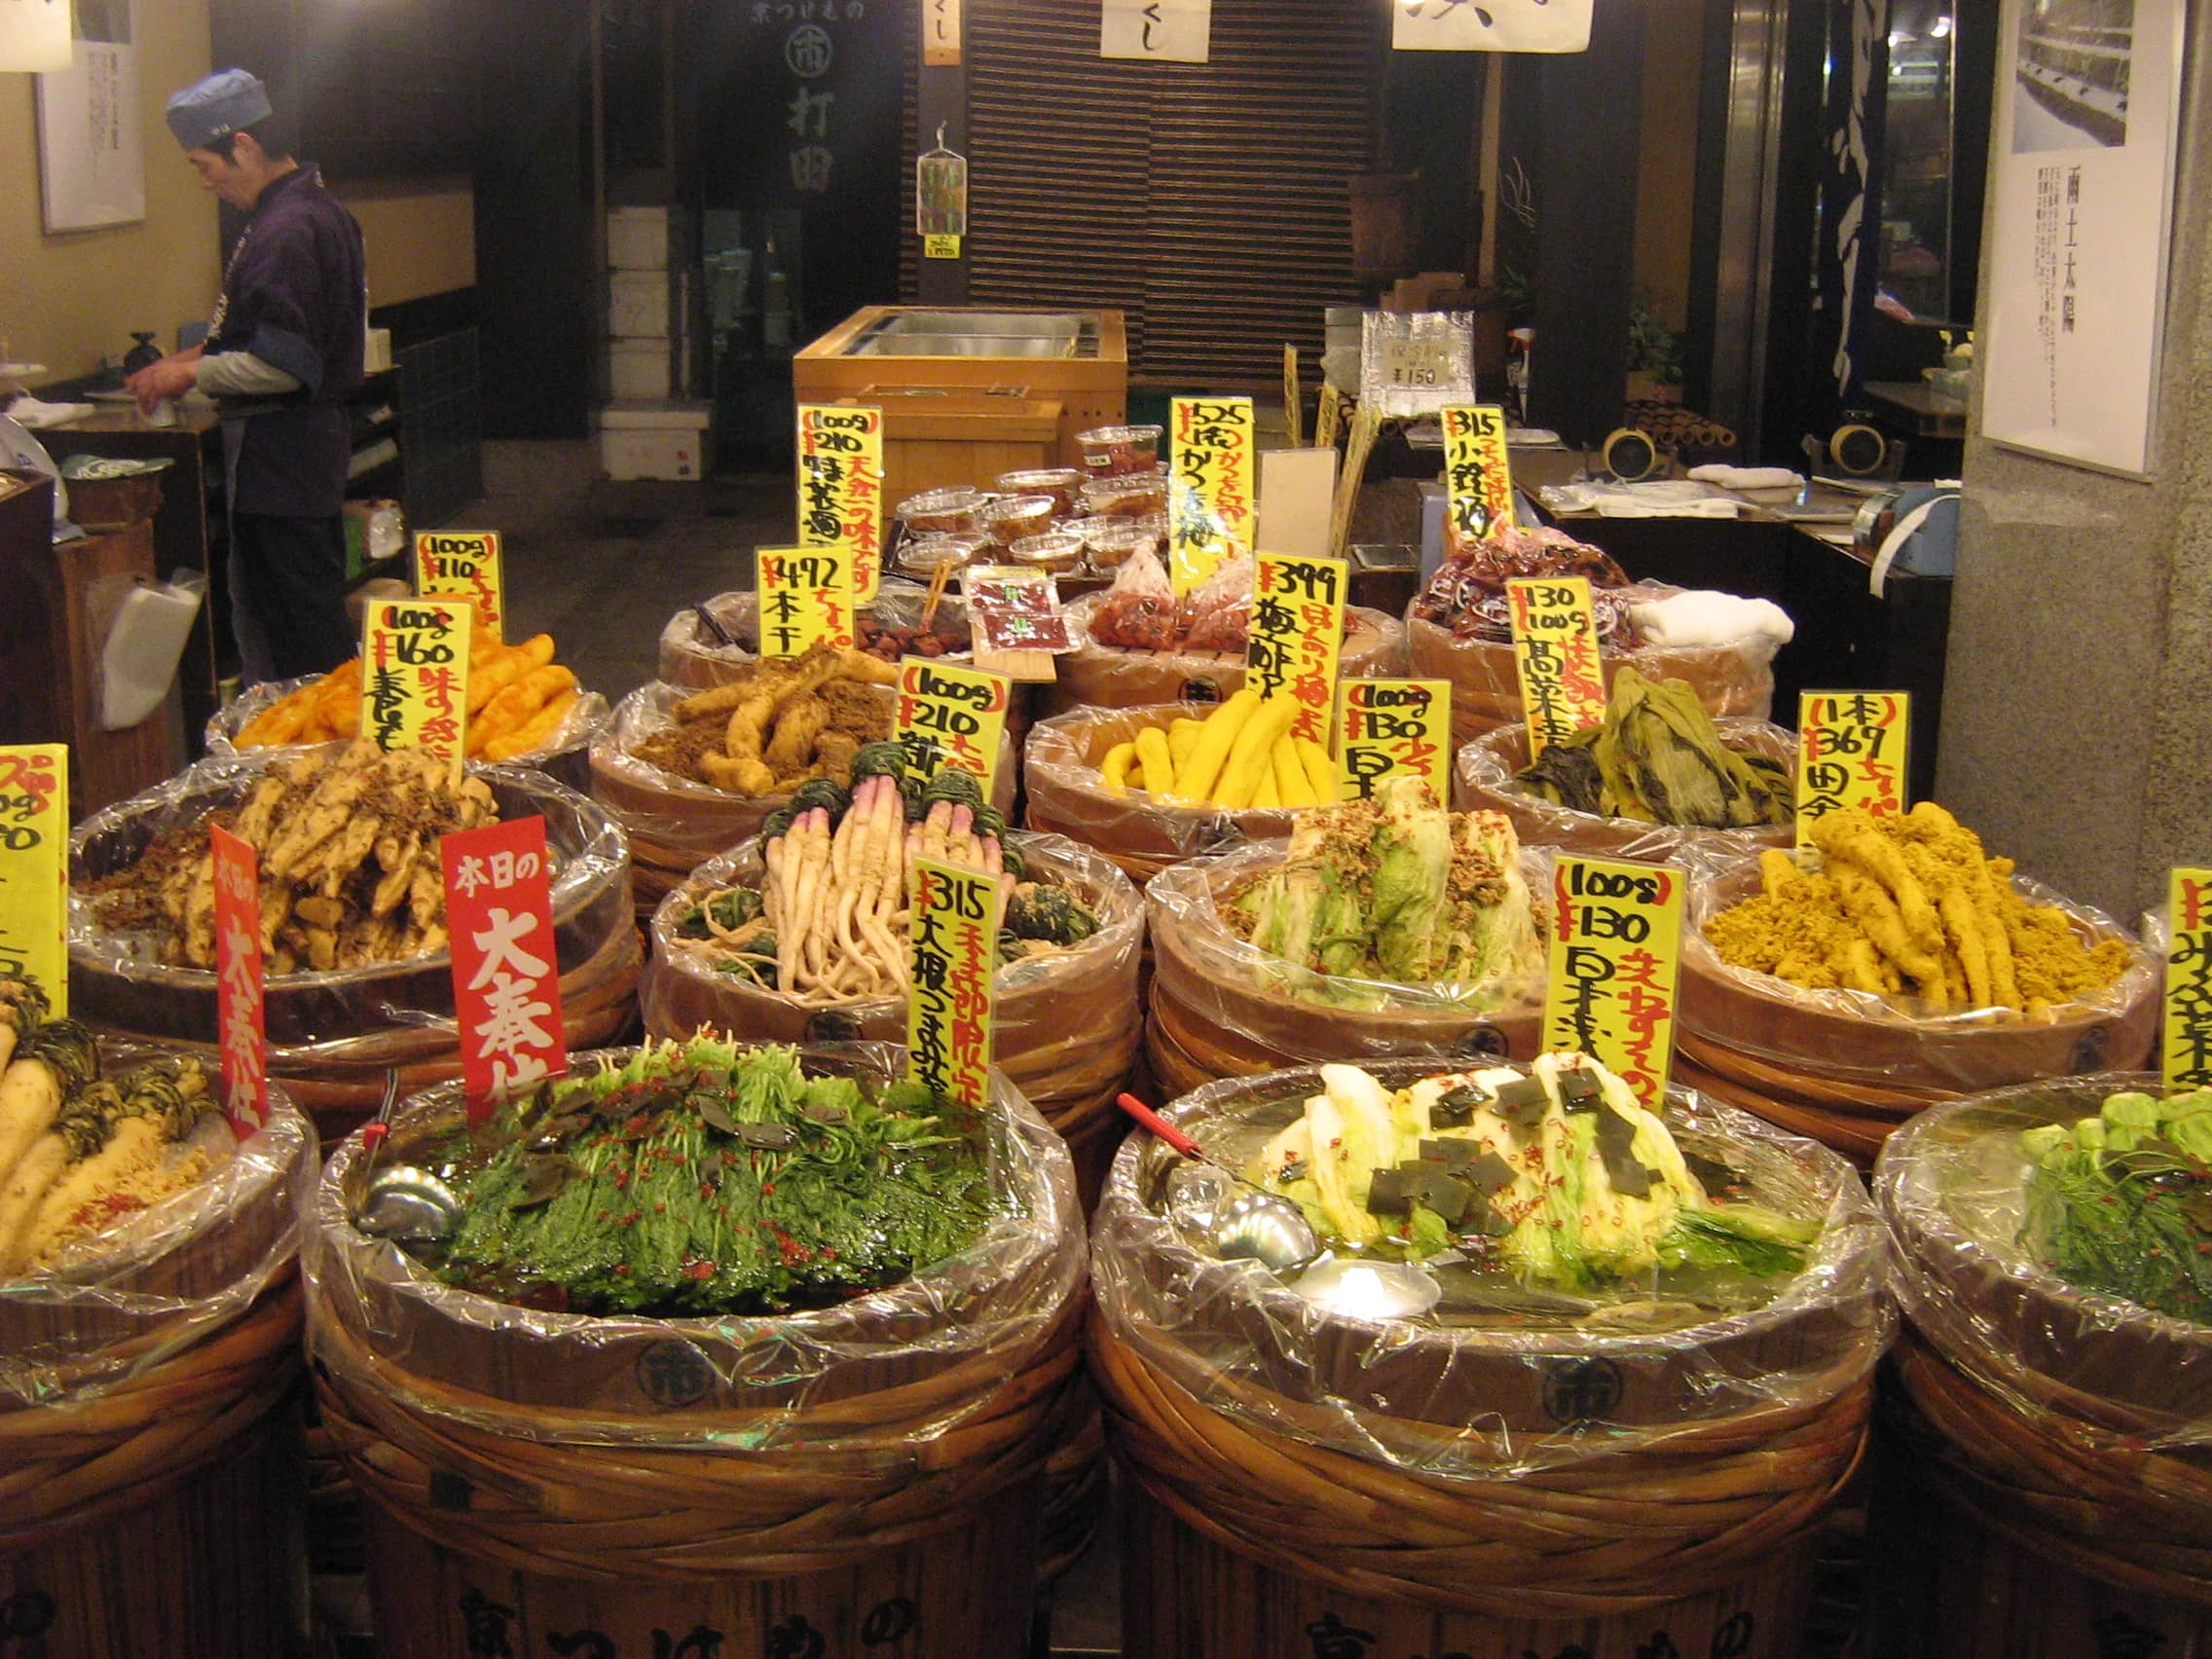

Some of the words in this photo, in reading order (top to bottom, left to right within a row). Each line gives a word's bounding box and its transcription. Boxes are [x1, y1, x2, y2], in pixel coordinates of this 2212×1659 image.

[788, 86, 834, 192] 打田
[454, 849, 540, 899] 本日の
